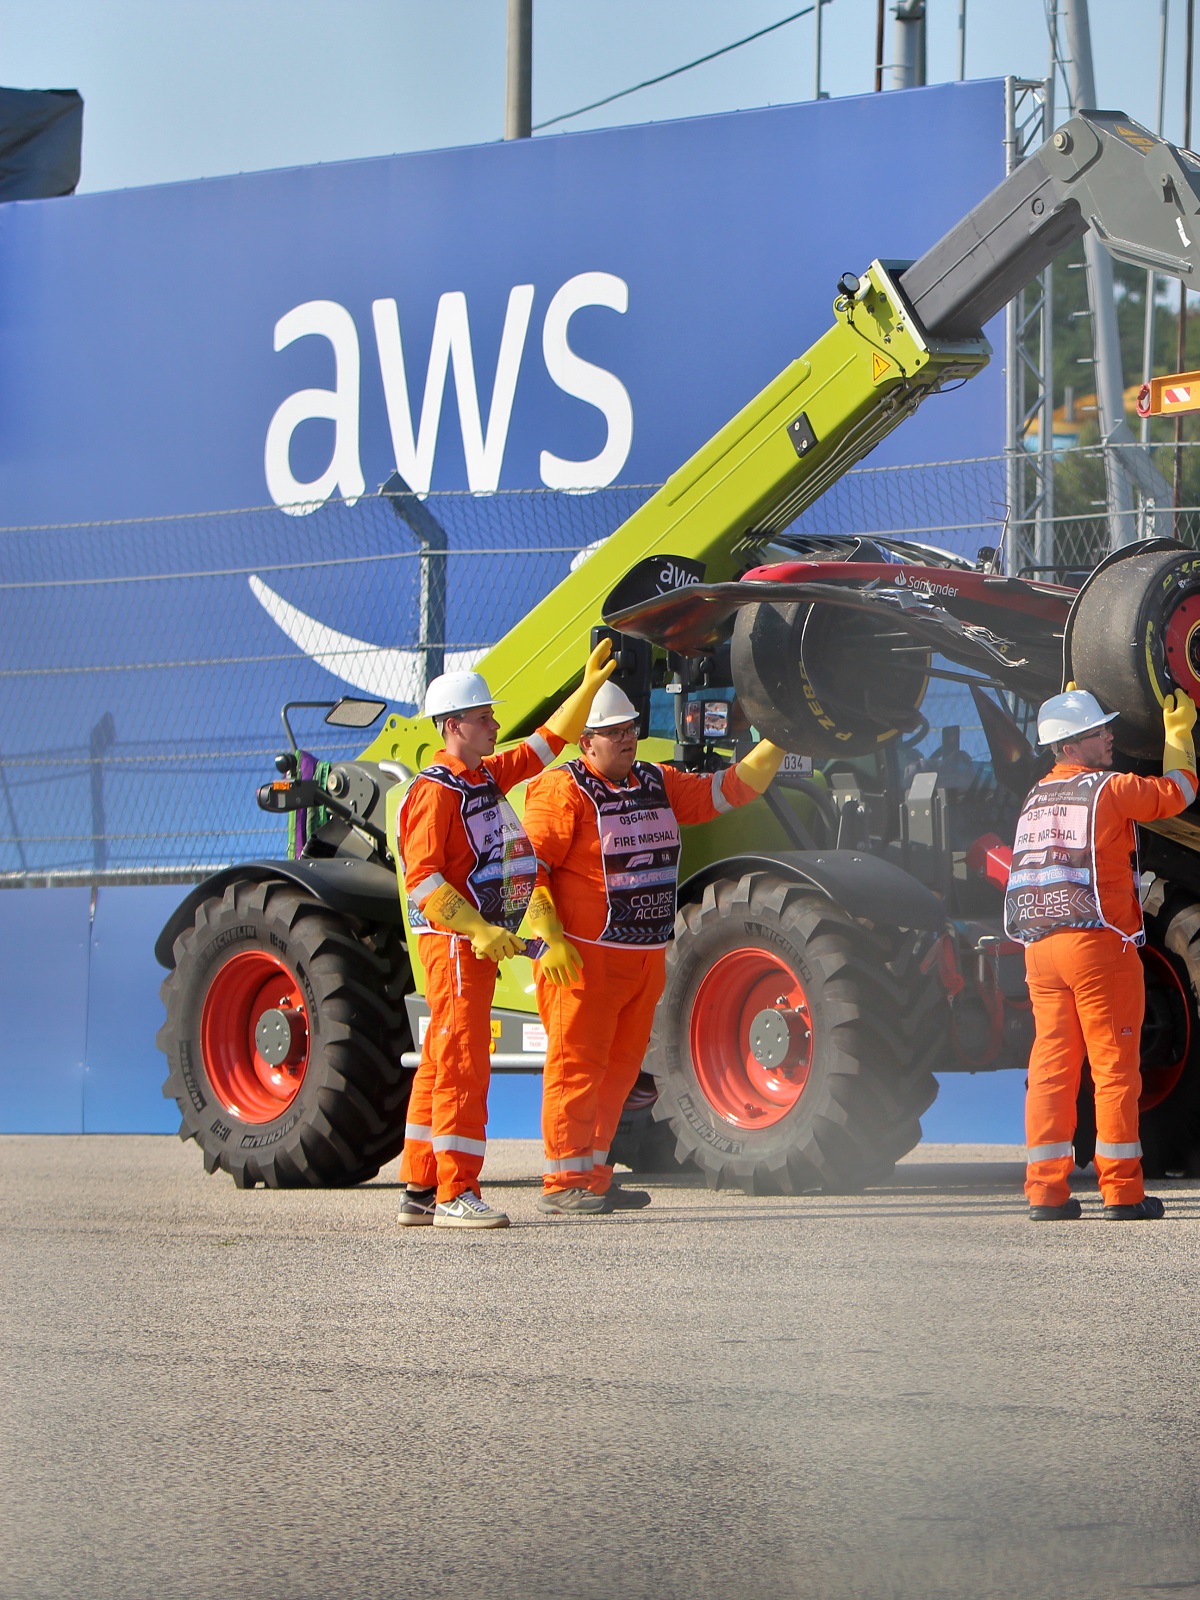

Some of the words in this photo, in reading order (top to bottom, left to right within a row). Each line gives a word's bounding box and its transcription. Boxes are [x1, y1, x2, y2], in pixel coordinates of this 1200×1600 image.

[264, 271, 633, 517] aws
[908, 576, 959, 597] Santander
[614, 836, 636, 848] FIRE
[630, 891, 673, 908] COURSE
[1017, 889, 1069, 907] COURSE
[634, 905, 671, 920] ACCESS
[1019, 903, 1071, 921] ACCESS
[206, 925, 257, 958] MICHELIN
[241, 1117, 296, 1148] MICHELIN
